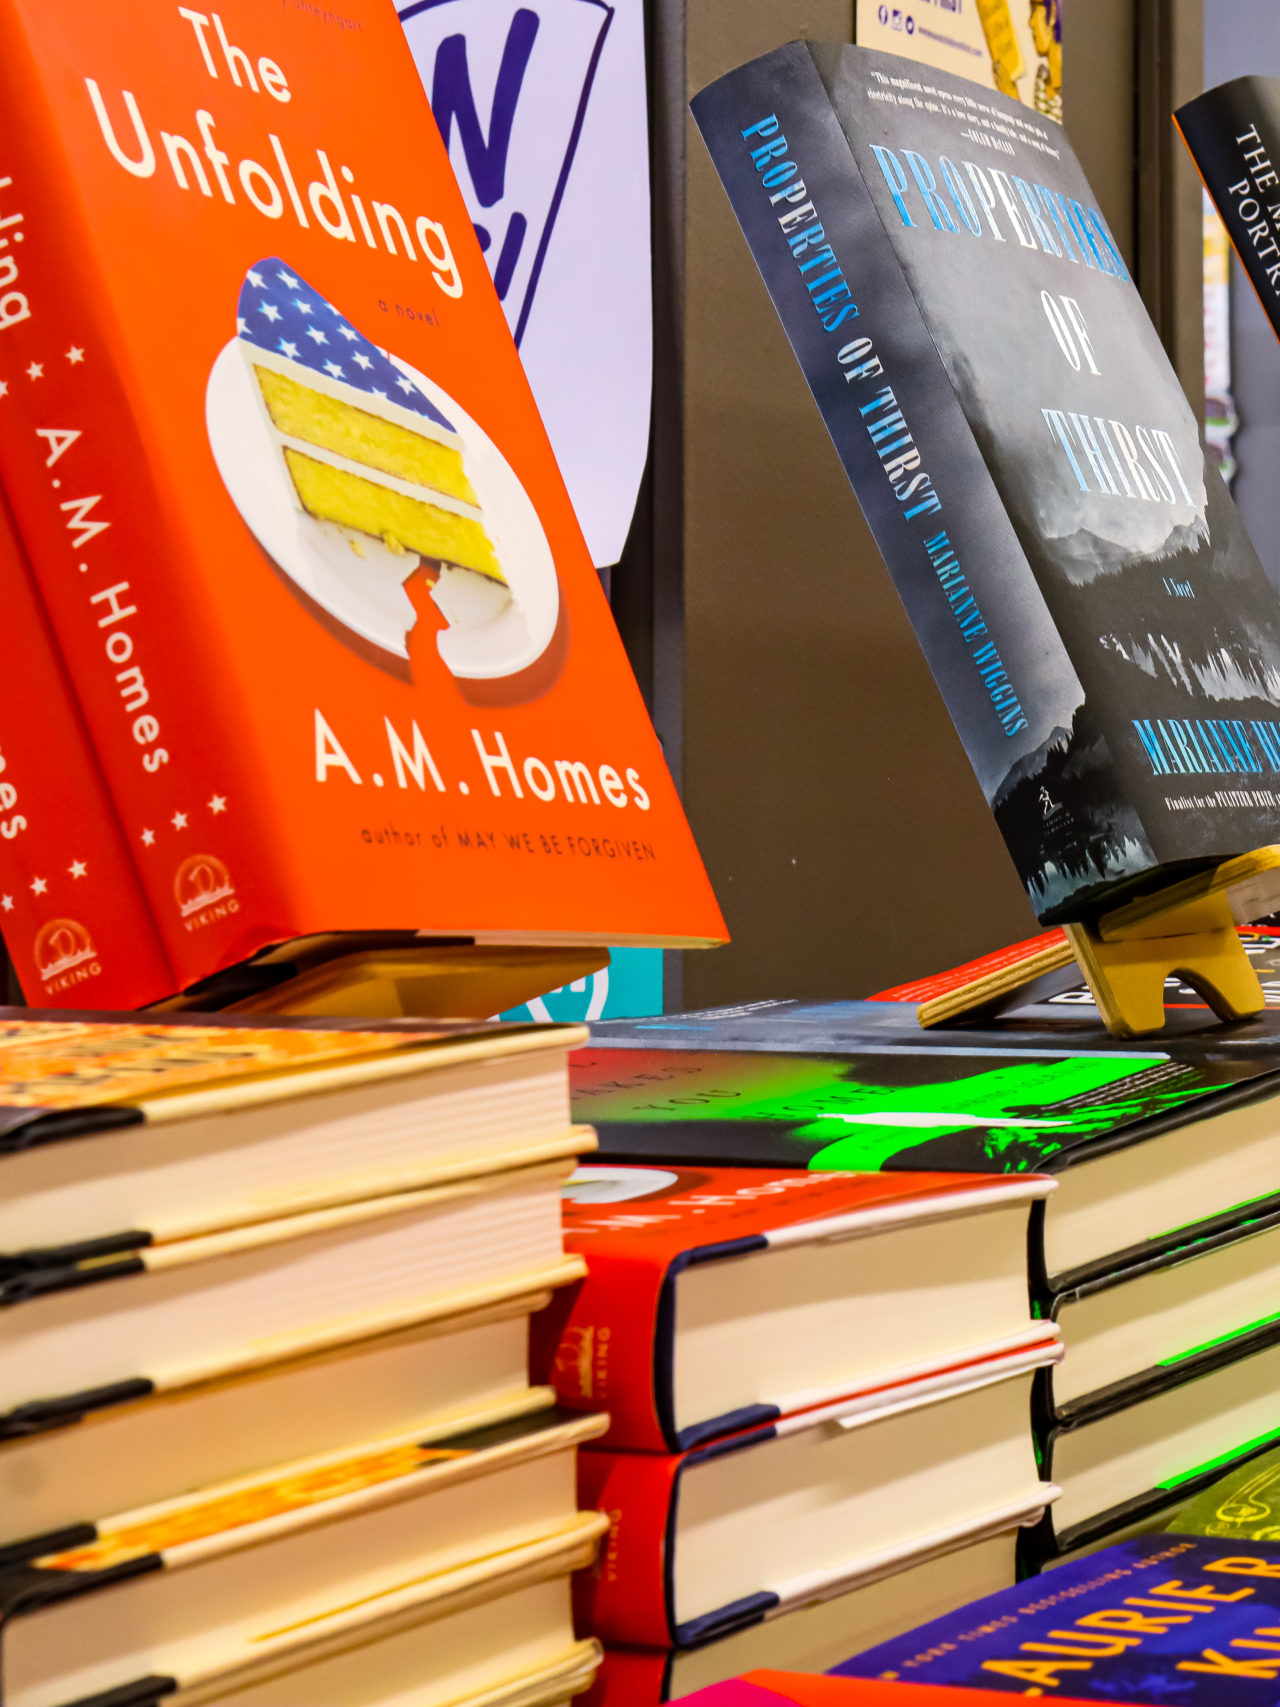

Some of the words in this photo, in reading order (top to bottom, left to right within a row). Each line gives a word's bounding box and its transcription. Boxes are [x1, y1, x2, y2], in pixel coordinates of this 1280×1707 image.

[178, 6, 291, 103] The
[85, 77, 464, 300] Unfolding
[1236, 123, 1280, 193] THE
[741, 113, 861, 333] PROPERTIES
[869, 143, 1129, 282] PROPERTIES
[378, 299, 389, 313] a
[394, 300, 441, 329] novel
[837, 337, 885, 385] OF
[1040, 290, 1102, 377] OF
[858, 385, 943, 522] THIRST
[1041, 408, 1196, 508] THIRST
[36, 428, 112, 572] A.M.
[90, 581, 169, 773] Homes
[923, 530, 989, 643] MARIANNE
[973, 640, 1030, 737] WIGGINS
[314, 707, 470, 796] A.M.
[471, 728, 651, 811] Homes
[1131, 719, 1264, 776] MARIANNE
[362, 823, 422, 848] author
[432, 825, 448, 849] of
[458, 831, 496, 850] MAY
[505, 832, 534, 853] WE
[543, 834, 563, 856] BE
[569, 836, 656, 861] FORGIVEN
[184, 900, 240, 932] VIKING
[45, 962, 102, 996] VIKING
[632, 1090, 742, 1112] YOU
[980, 1579, 1256, 1697] AURIE
